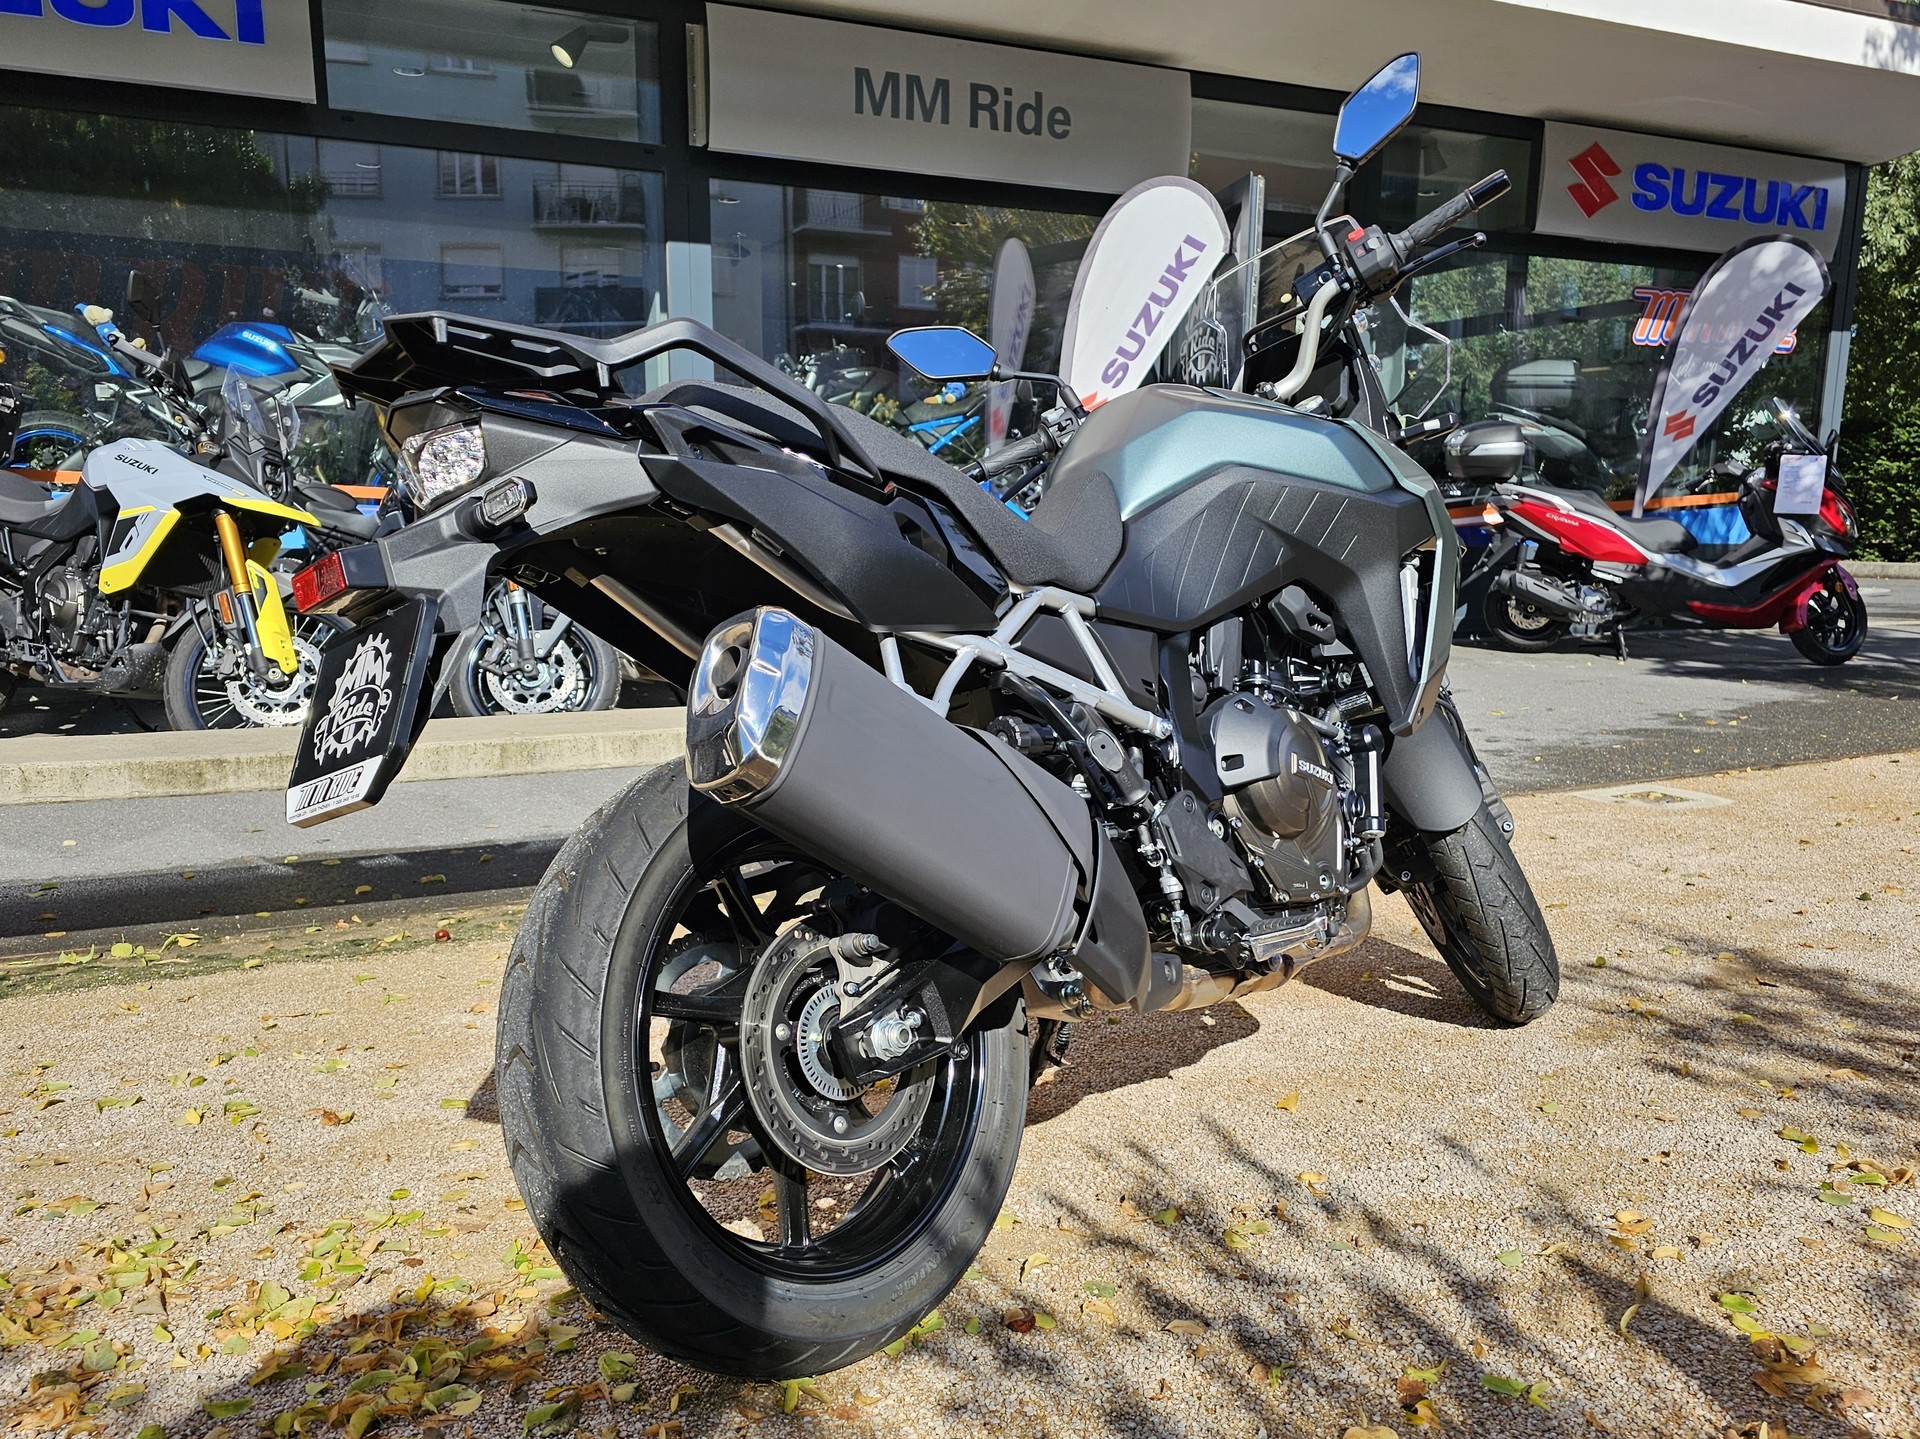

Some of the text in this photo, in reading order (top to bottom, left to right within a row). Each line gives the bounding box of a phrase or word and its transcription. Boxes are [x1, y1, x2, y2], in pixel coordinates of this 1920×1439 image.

[854, 66, 1072, 140] MM Ride
[1630, 162, 1829, 231] SUZUKI
[1101, 234, 1207, 389] SUZUKI
[1692, 281, 1807, 409] SUZUKI
[114, 453, 159, 475] SUZUKI
[332, 693, 374, 731] Ride
[1298, 759, 1334, 785] SUZUKI
